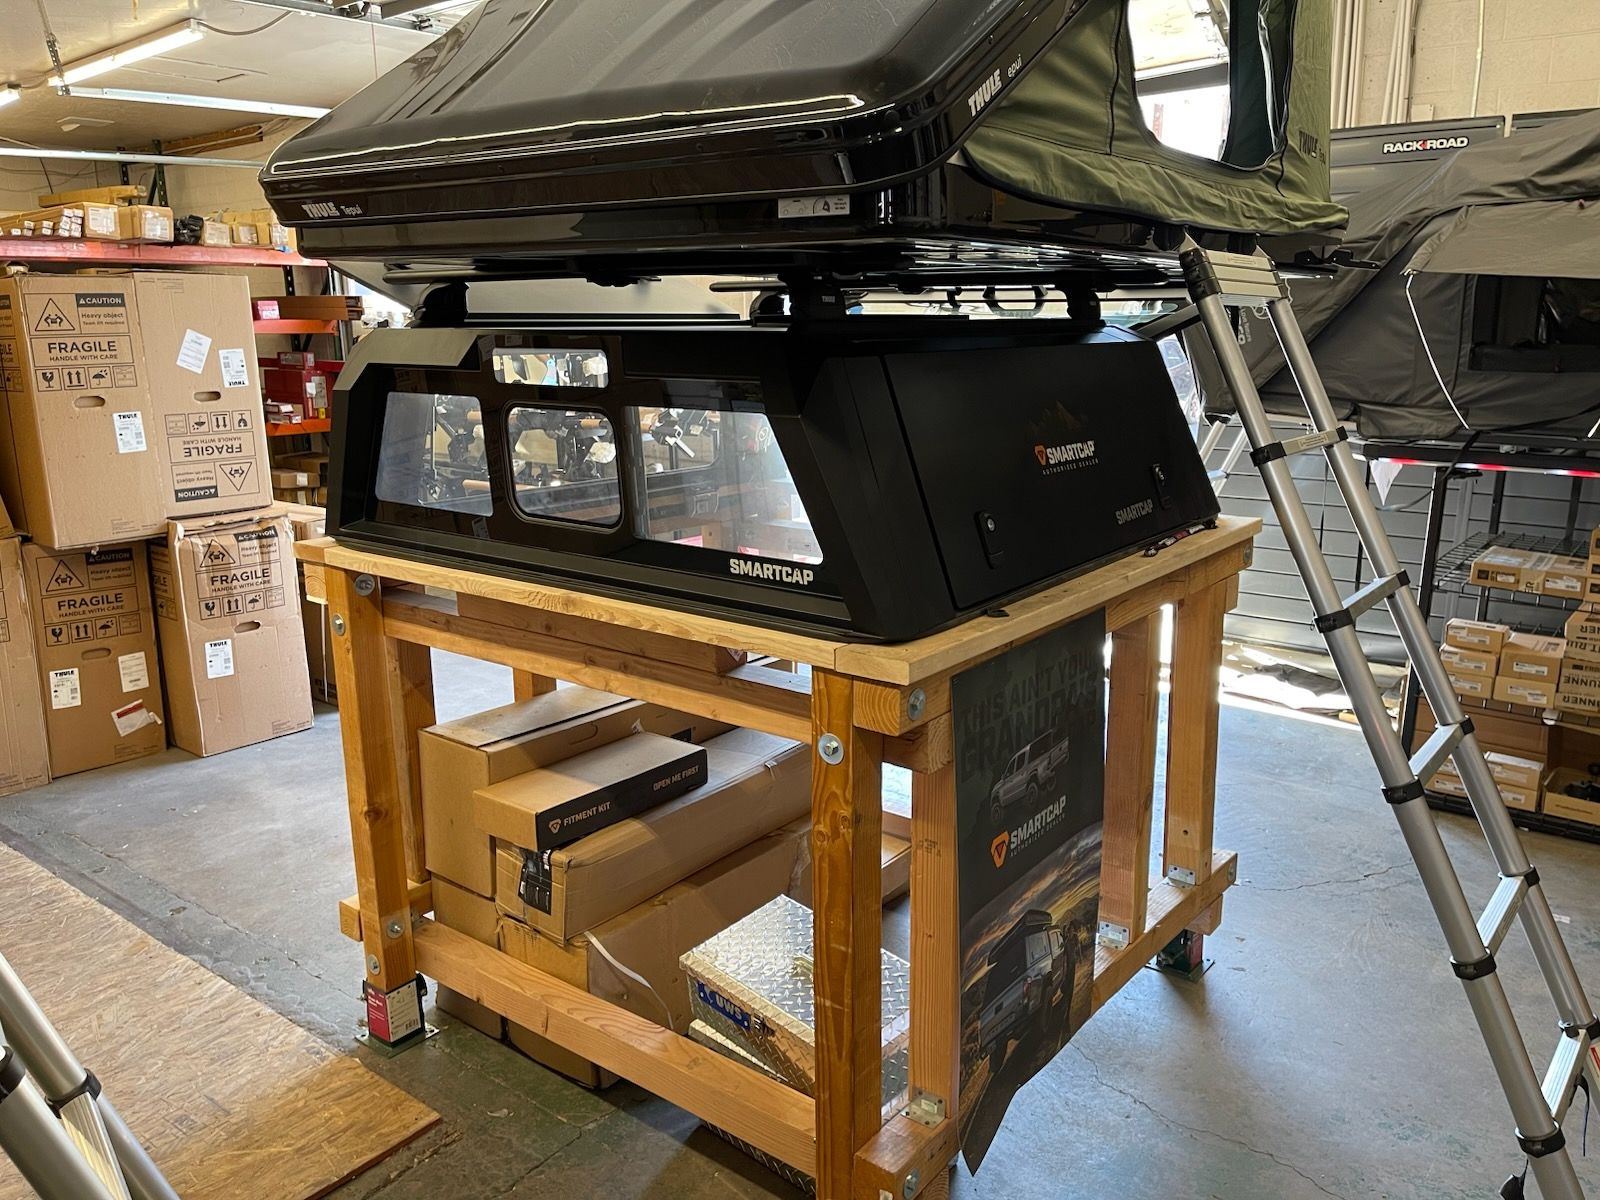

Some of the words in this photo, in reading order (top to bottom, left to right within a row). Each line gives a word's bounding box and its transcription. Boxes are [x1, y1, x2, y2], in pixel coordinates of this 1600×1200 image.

[968, 68, 1002, 117] THULE
[301, 202, 340, 218] THULE
[340, 204, 363, 216] Tepui
[47, 341, 117, 353] FRAGILE
[183, 443, 242, 457] FRAGILE
[1046, 440, 1095, 464] SMARTCAP
[178, 489, 210, 498] CAUTION
[1115, 499, 1153, 524] SMARTCAP
[95, 553, 130, 561] CAUTION
[211, 568, 270, 586] FRAGILE
[729, 558, 814, 585] SMARTCAP
[212, 585, 237, 593] HANDLE
[57, 593, 124, 611] FRAGILE
[59, 610, 86, 618] HANDLE
[653, 778, 671, 792] OPEN
[671, 775, 682, 784] ME
[682, 765, 700, 779] FIRST
[563, 806, 598, 827] FITMENT
[598, 802, 611, 813] KIT
[1010, 795, 1067, 850] SMARTCAP
[715, 993, 743, 1020] UWS
